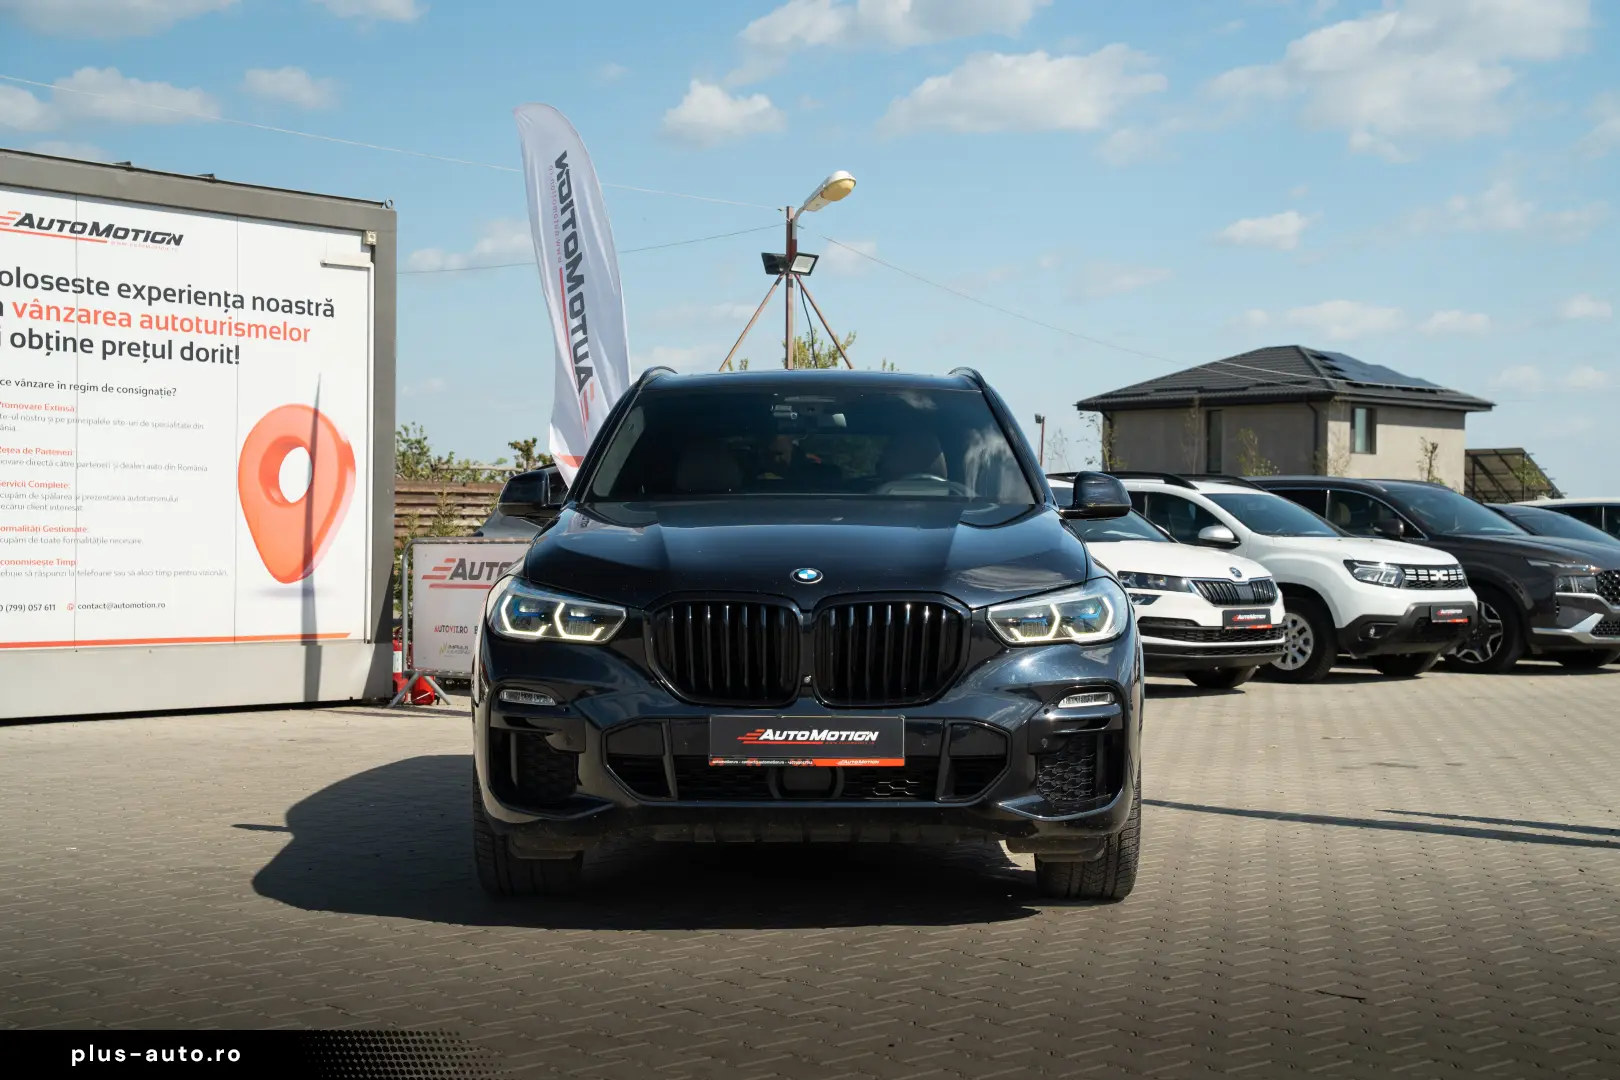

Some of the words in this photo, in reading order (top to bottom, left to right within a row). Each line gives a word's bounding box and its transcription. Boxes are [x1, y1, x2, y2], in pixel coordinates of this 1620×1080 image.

[117, 282, 245, 313] experiența
[252, 295, 335, 318] noastră
[11, 298, 132, 328] vânzarea
[139, 312, 311, 343] autoturismelor
[10, 327, 94, 356] obține
[102, 338, 173, 364] prețul
[180, 340, 240, 365] dorit!
[14, 377, 55, 390] vânzare
[69, 382, 99, 394] regim
[101, 383, 114, 394] de
[116, 384, 177, 399] consignație?
[0, 400, 42, 412] romovare
[5, 604, 26, 614] (799)
[28, 604, 43, 613] 057
[44, 604, 56, 612] 611
[77, 602, 166, 611] contact@automotion.ro
